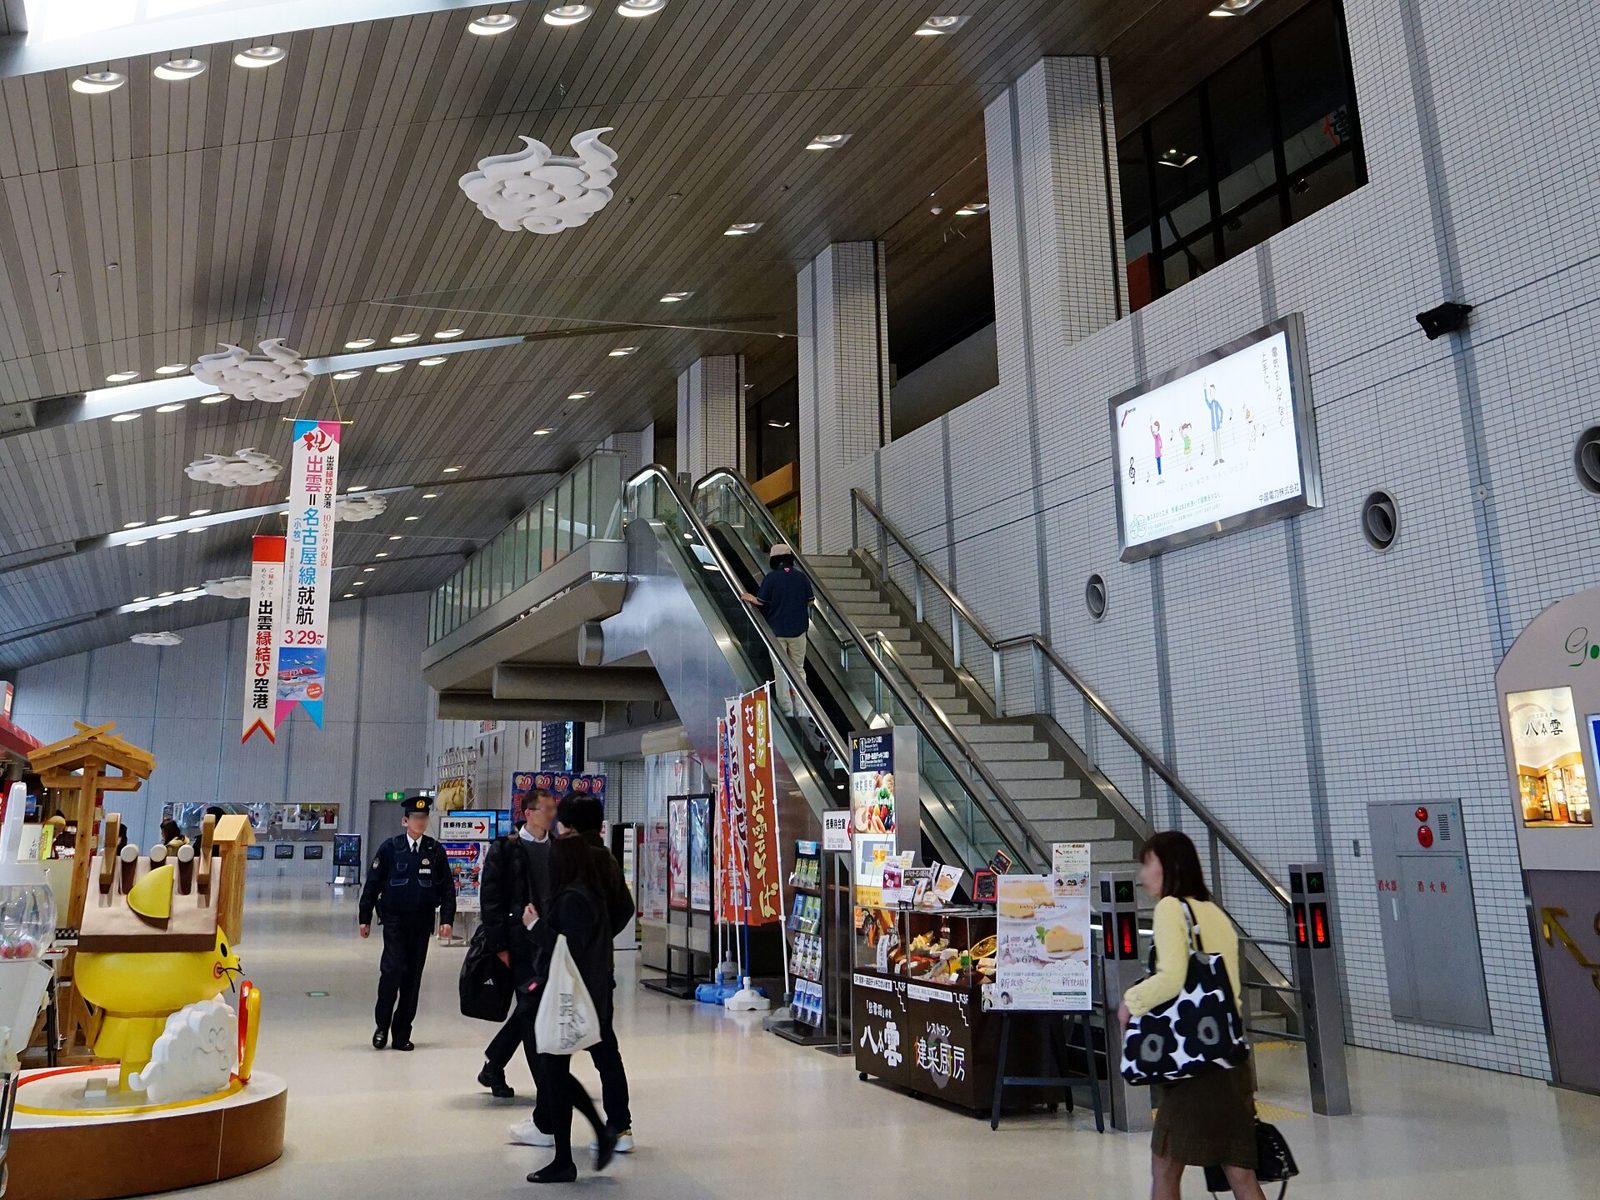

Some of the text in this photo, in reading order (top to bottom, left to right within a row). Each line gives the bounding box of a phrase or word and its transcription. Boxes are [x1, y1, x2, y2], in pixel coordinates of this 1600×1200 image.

[301, 430, 334, 453] 祝
[323, 455, 335, 509] 出雲縁結び空港
[253, 600, 273, 709] 出雲縁結び空港
[751, 779, 779, 918] 出雲そば
[1378, 879, 1398, 892] 消火器
[1417, 880, 1448, 893] 消火栓
[926, 1021, 952, 1038] レストラン
